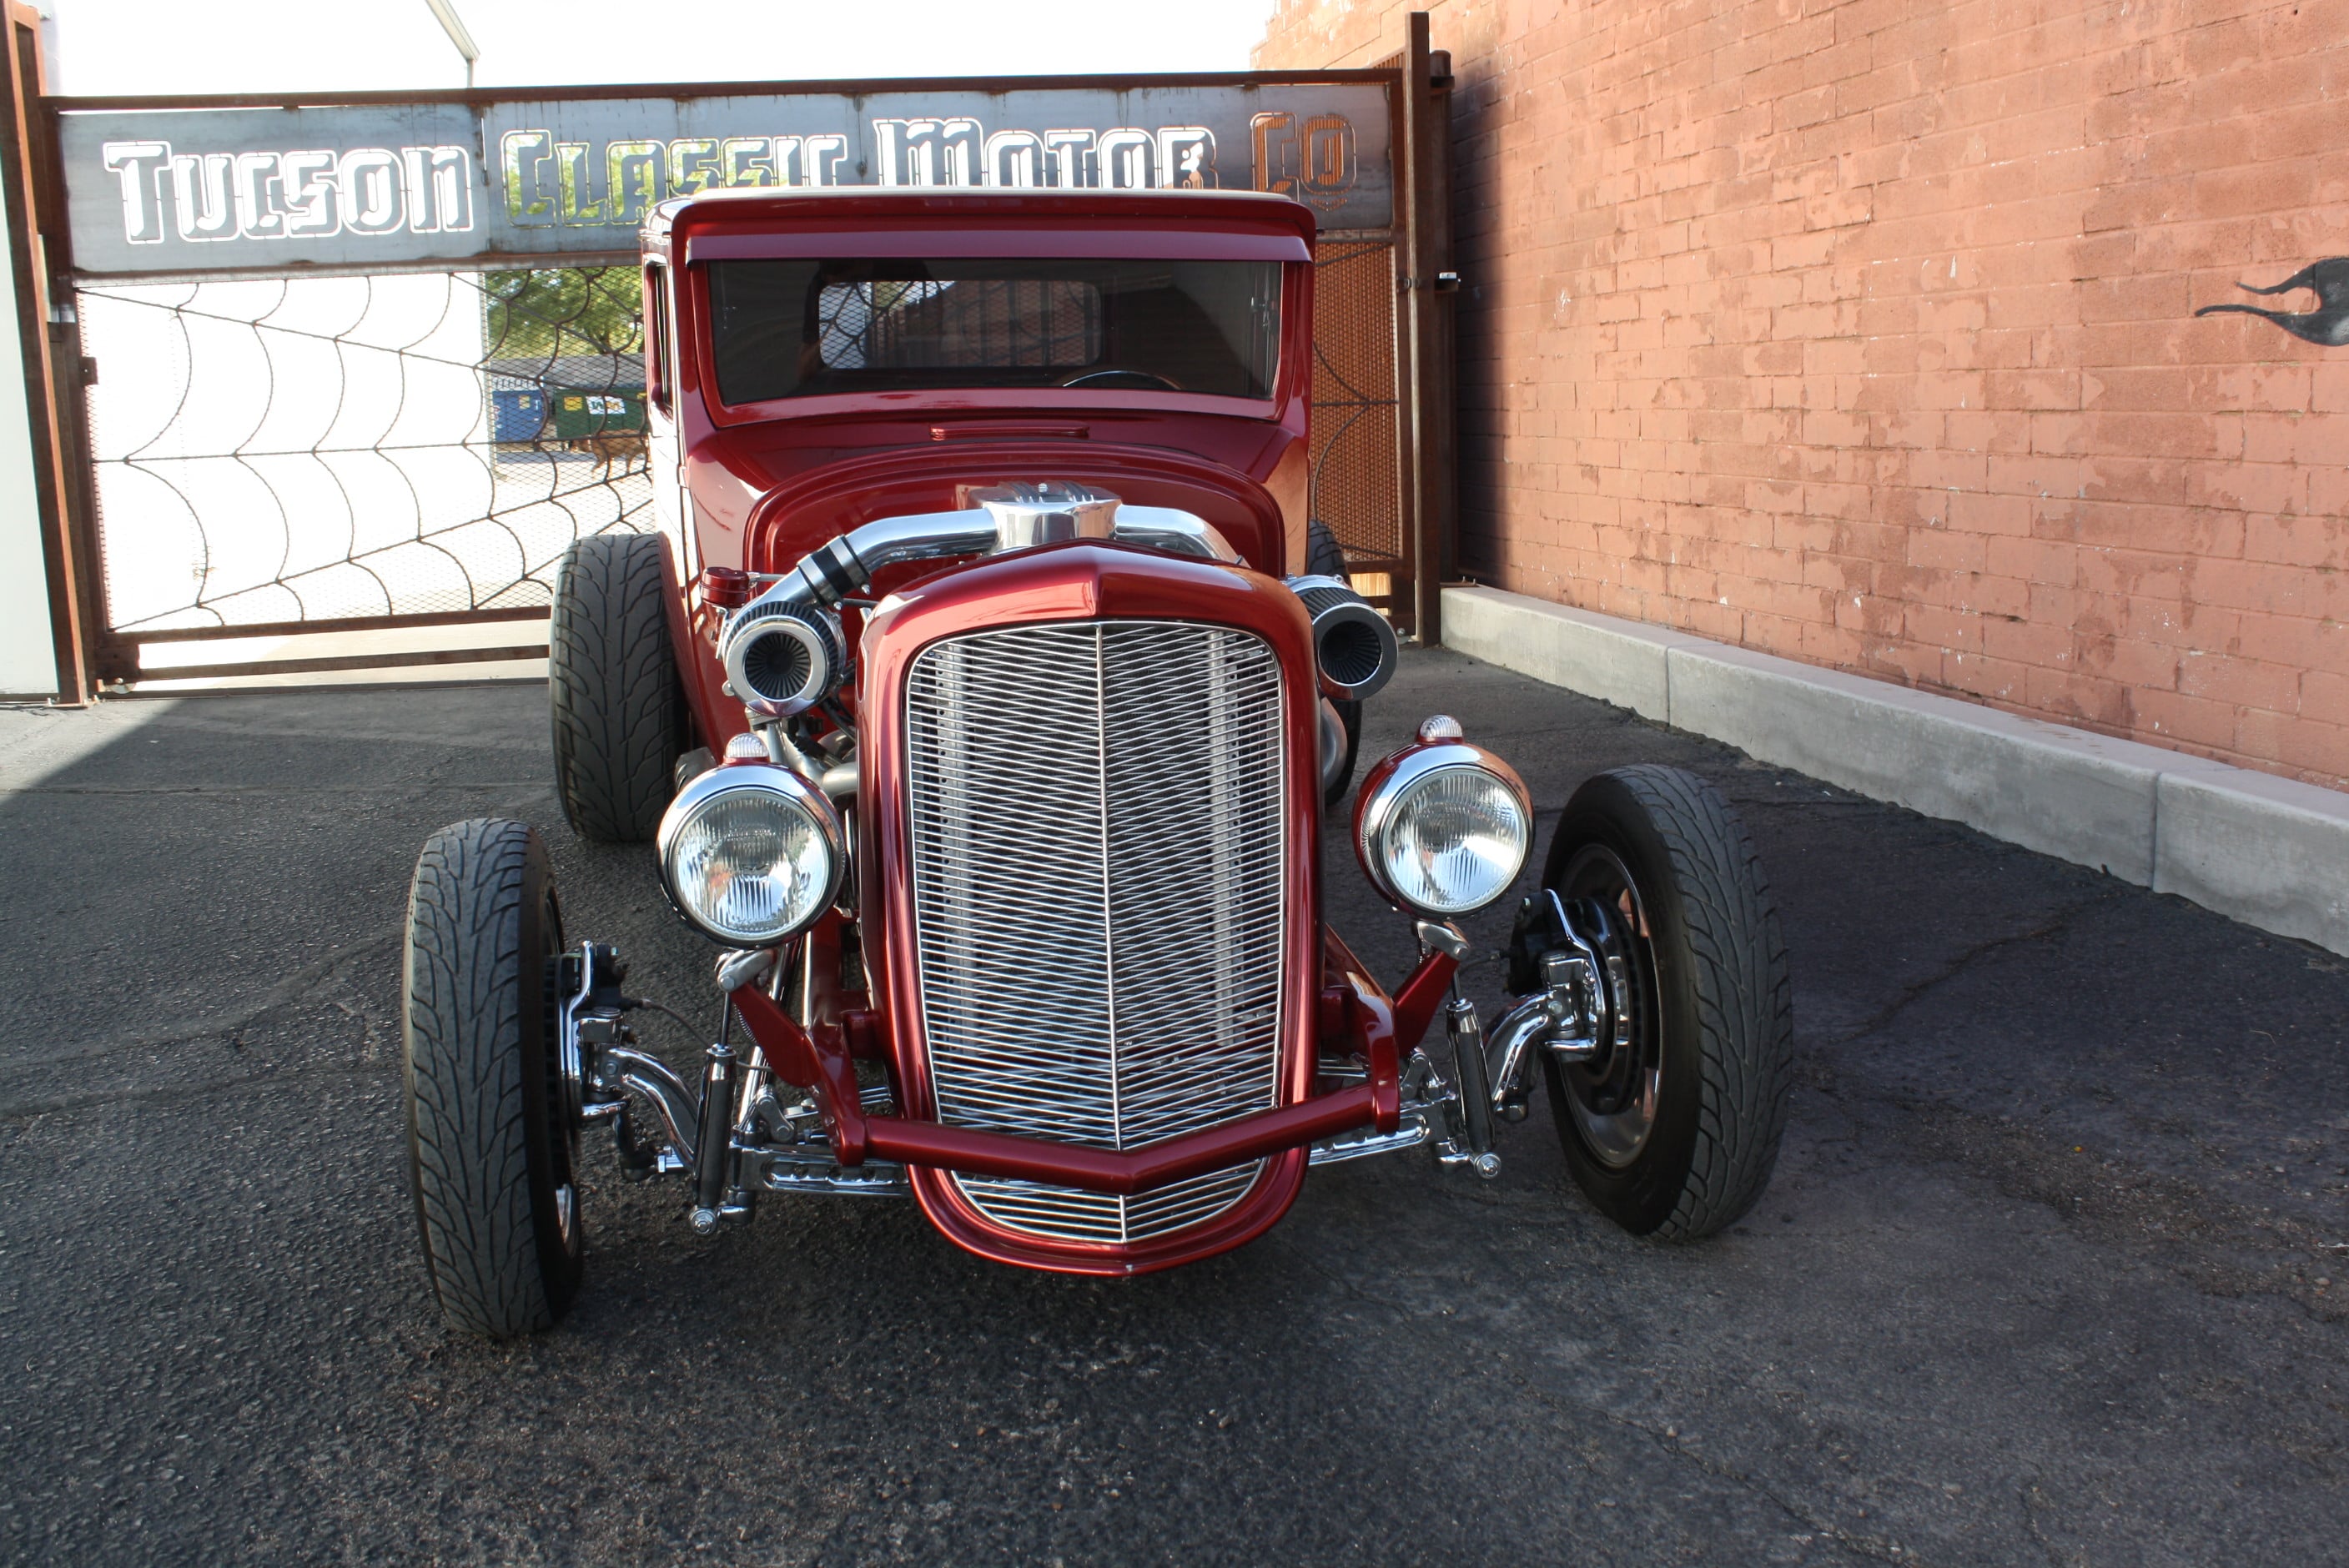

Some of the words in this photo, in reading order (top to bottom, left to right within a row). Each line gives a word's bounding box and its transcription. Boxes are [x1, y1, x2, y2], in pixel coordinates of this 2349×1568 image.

[103, 140, 474, 244] TUCSON
[872, 118, 1218, 189] MOTOR
[1250, 112, 1356, 203] CO
